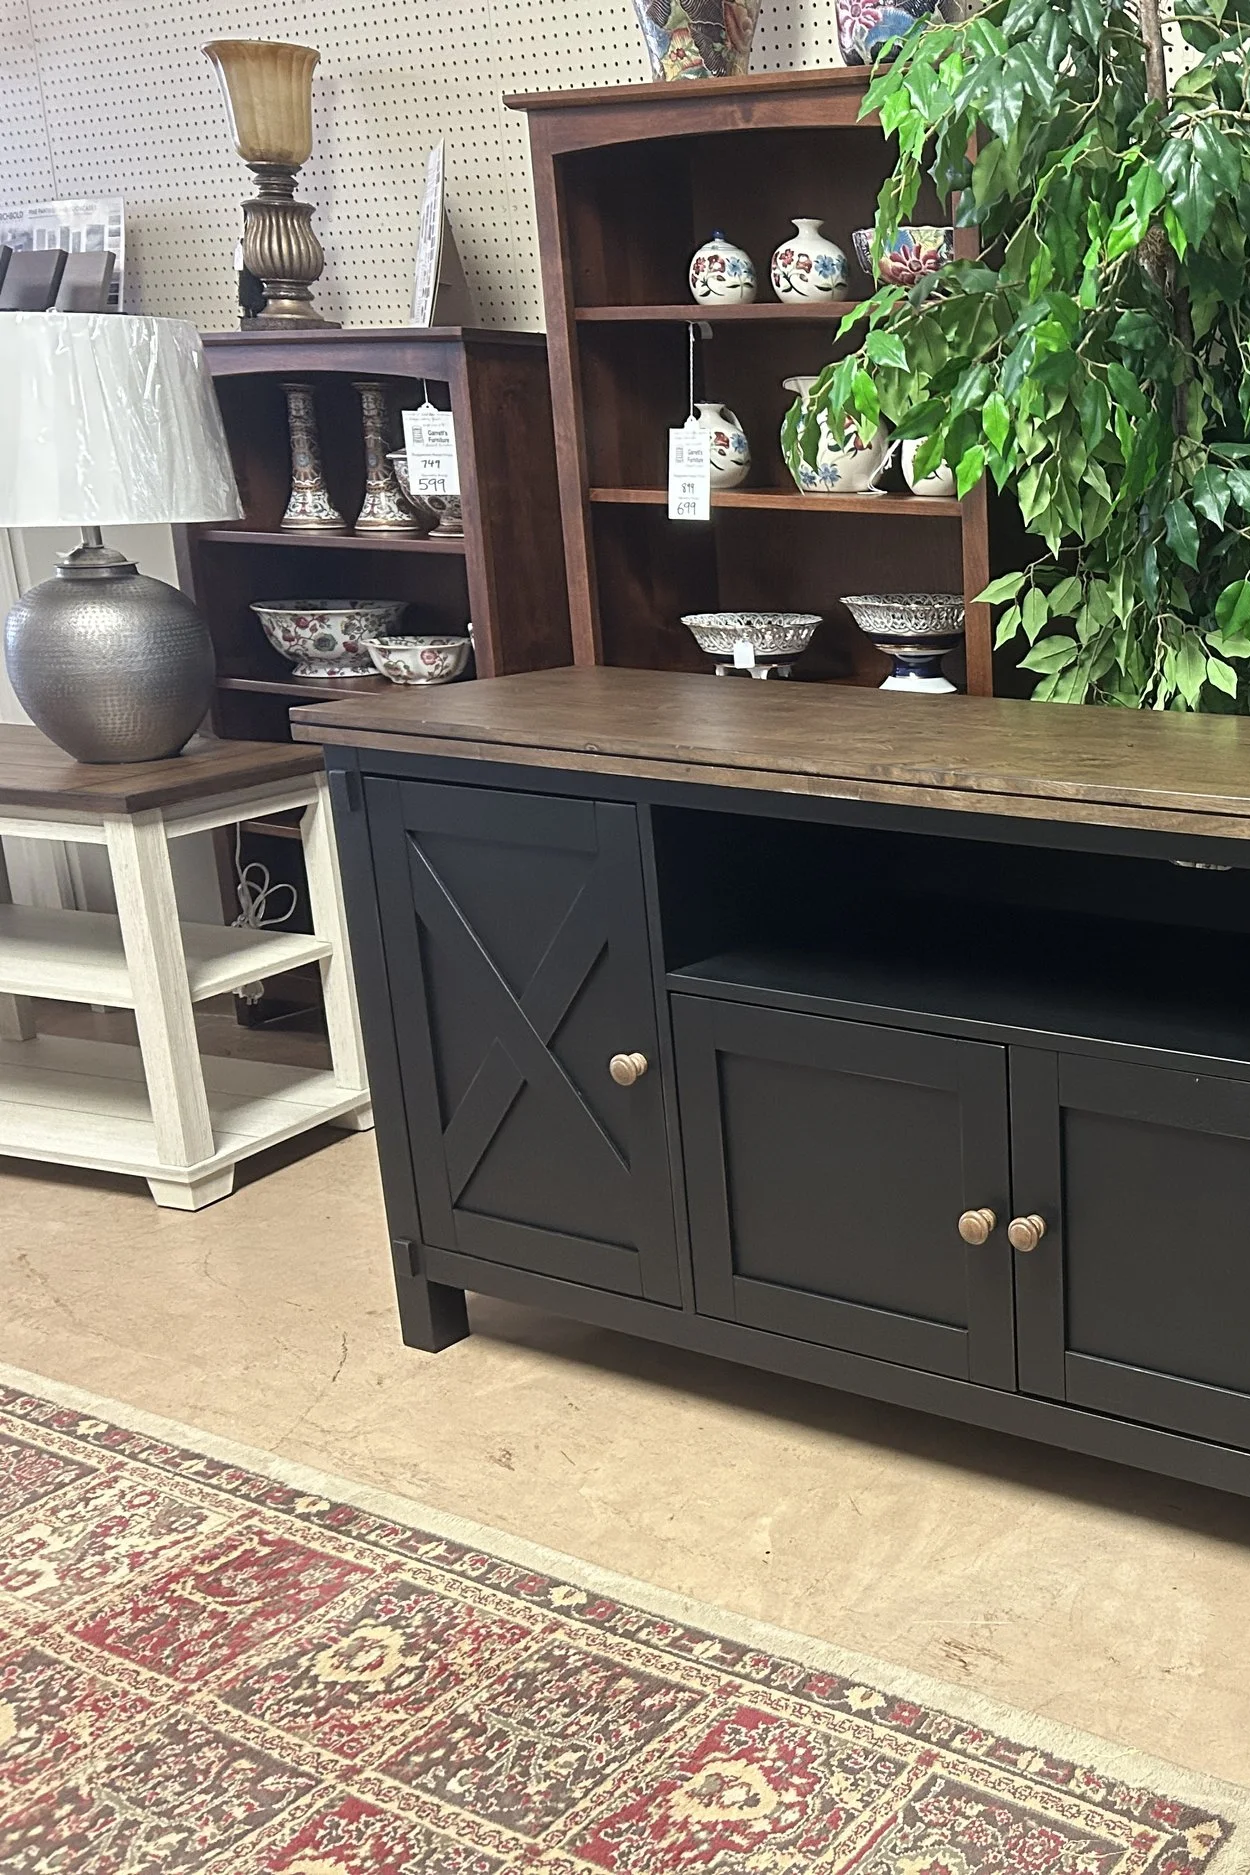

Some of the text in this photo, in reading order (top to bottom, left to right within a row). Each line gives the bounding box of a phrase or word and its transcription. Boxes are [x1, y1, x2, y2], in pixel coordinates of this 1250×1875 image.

[421, 459, 441, 469] 749
[418, 478, 446, 493] 599
[681, 482, 695, 494] 899
[676, 501, 696, 516] 699
